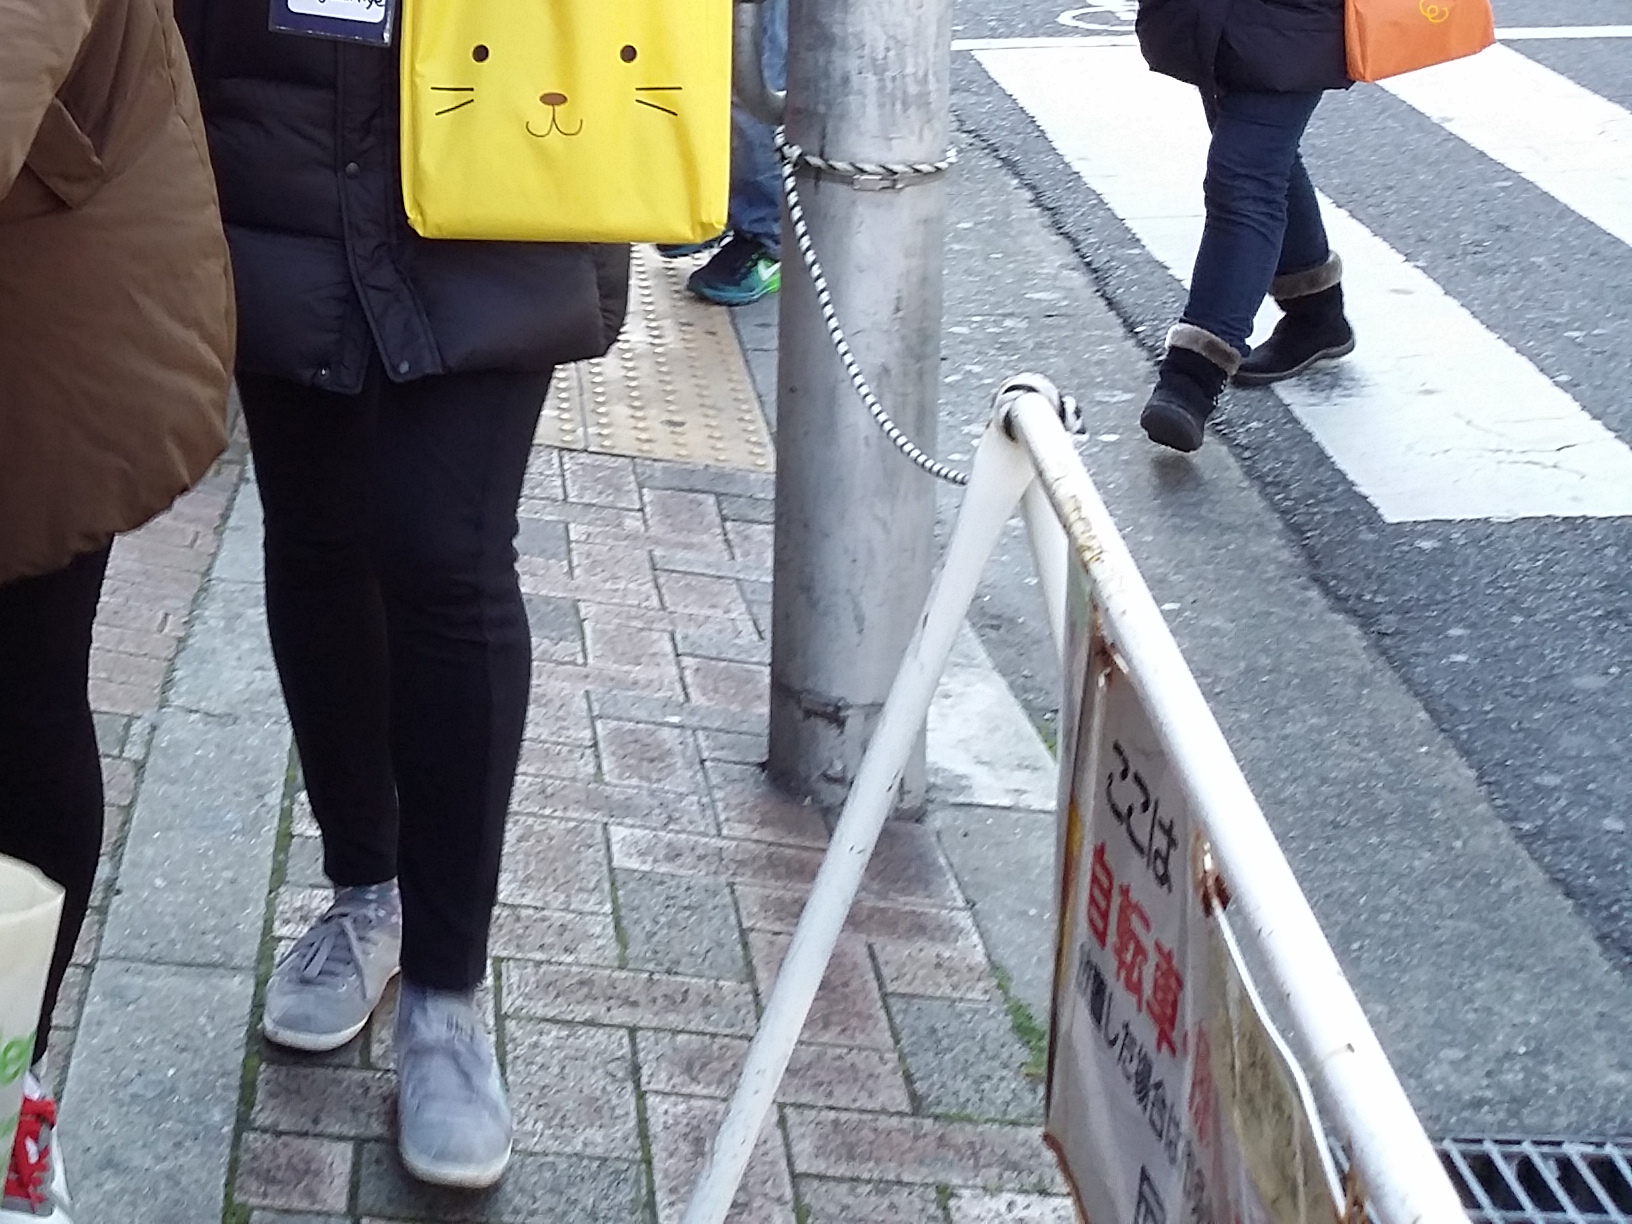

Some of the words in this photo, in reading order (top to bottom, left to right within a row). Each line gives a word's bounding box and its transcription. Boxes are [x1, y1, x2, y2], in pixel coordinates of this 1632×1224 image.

[1106, 741, 1178, 894] ここは
[1087, 841, 1185, 1059] 自転車
